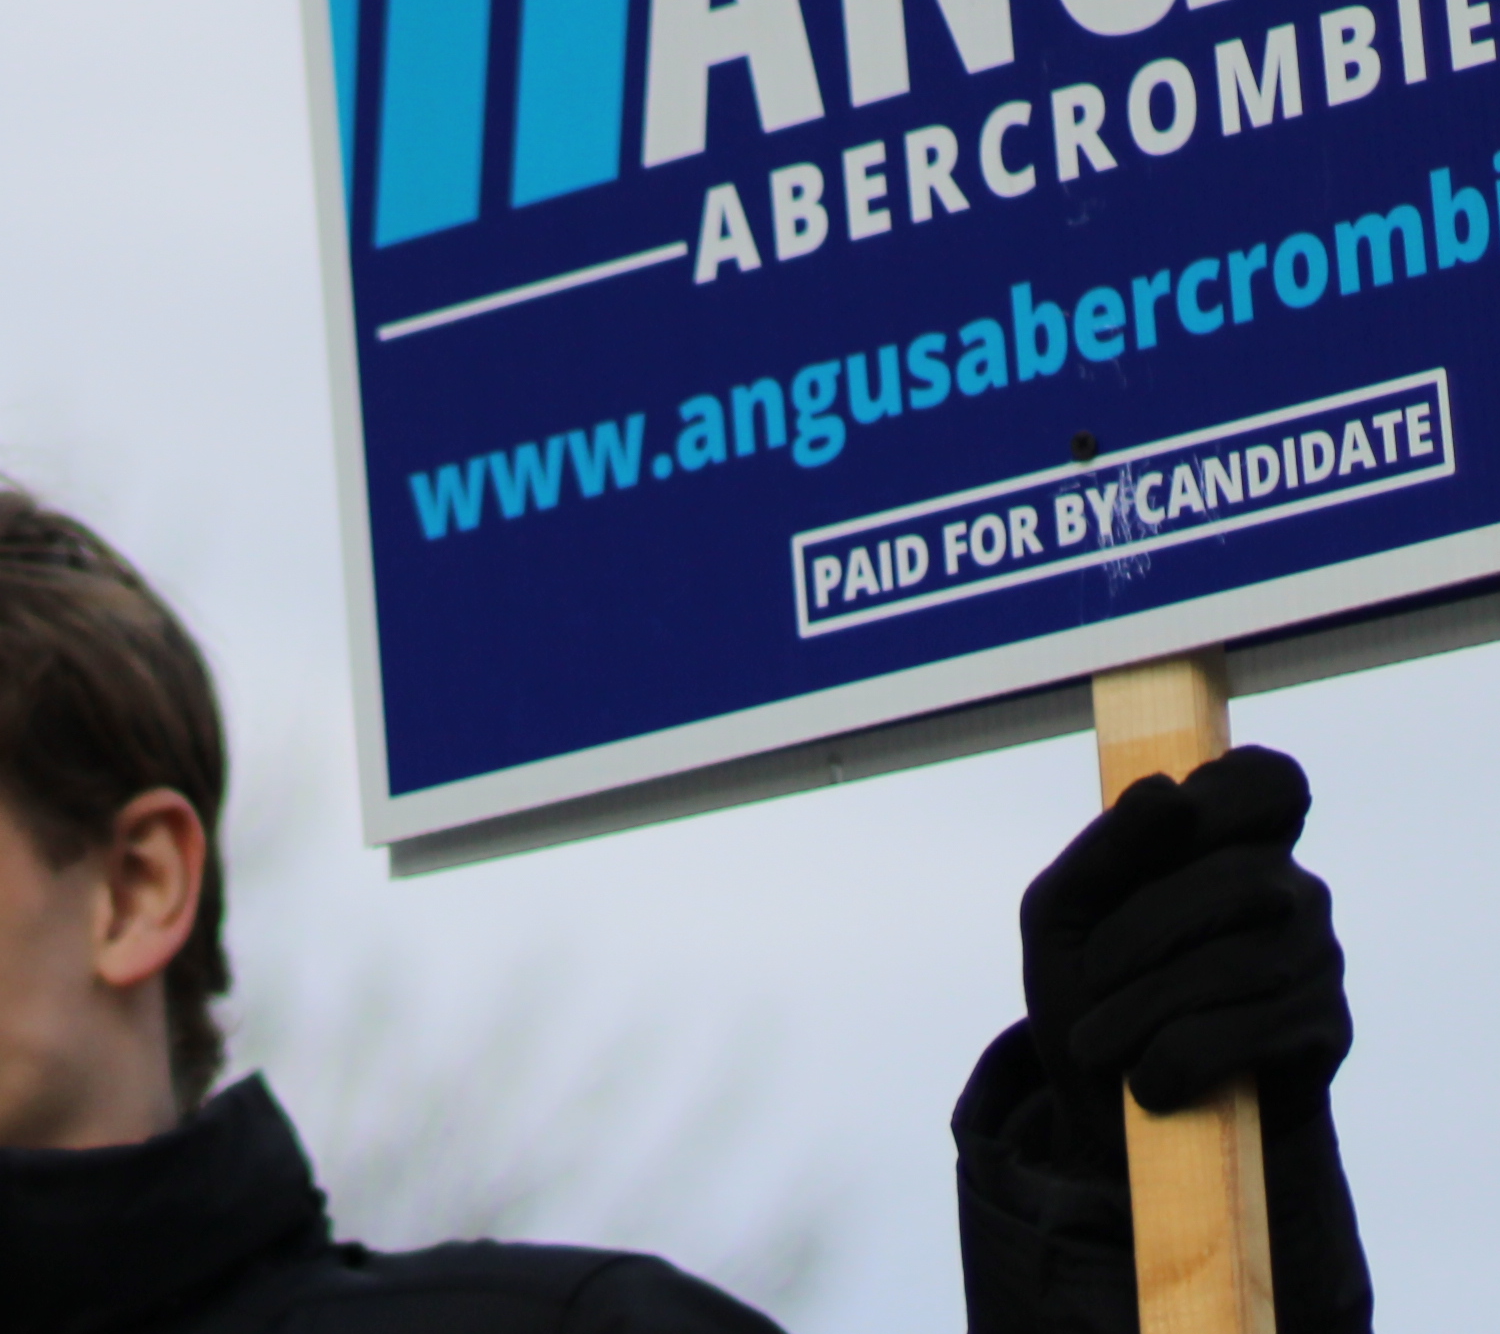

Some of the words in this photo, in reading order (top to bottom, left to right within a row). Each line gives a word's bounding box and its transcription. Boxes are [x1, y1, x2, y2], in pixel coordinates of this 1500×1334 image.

[813, 532, 928, 609] PAID
[943, 505, 1043, 575] FOR
[1055, 483, 1120, 547] BY
[1134, 401, 1434, 520] CANDIDATE
